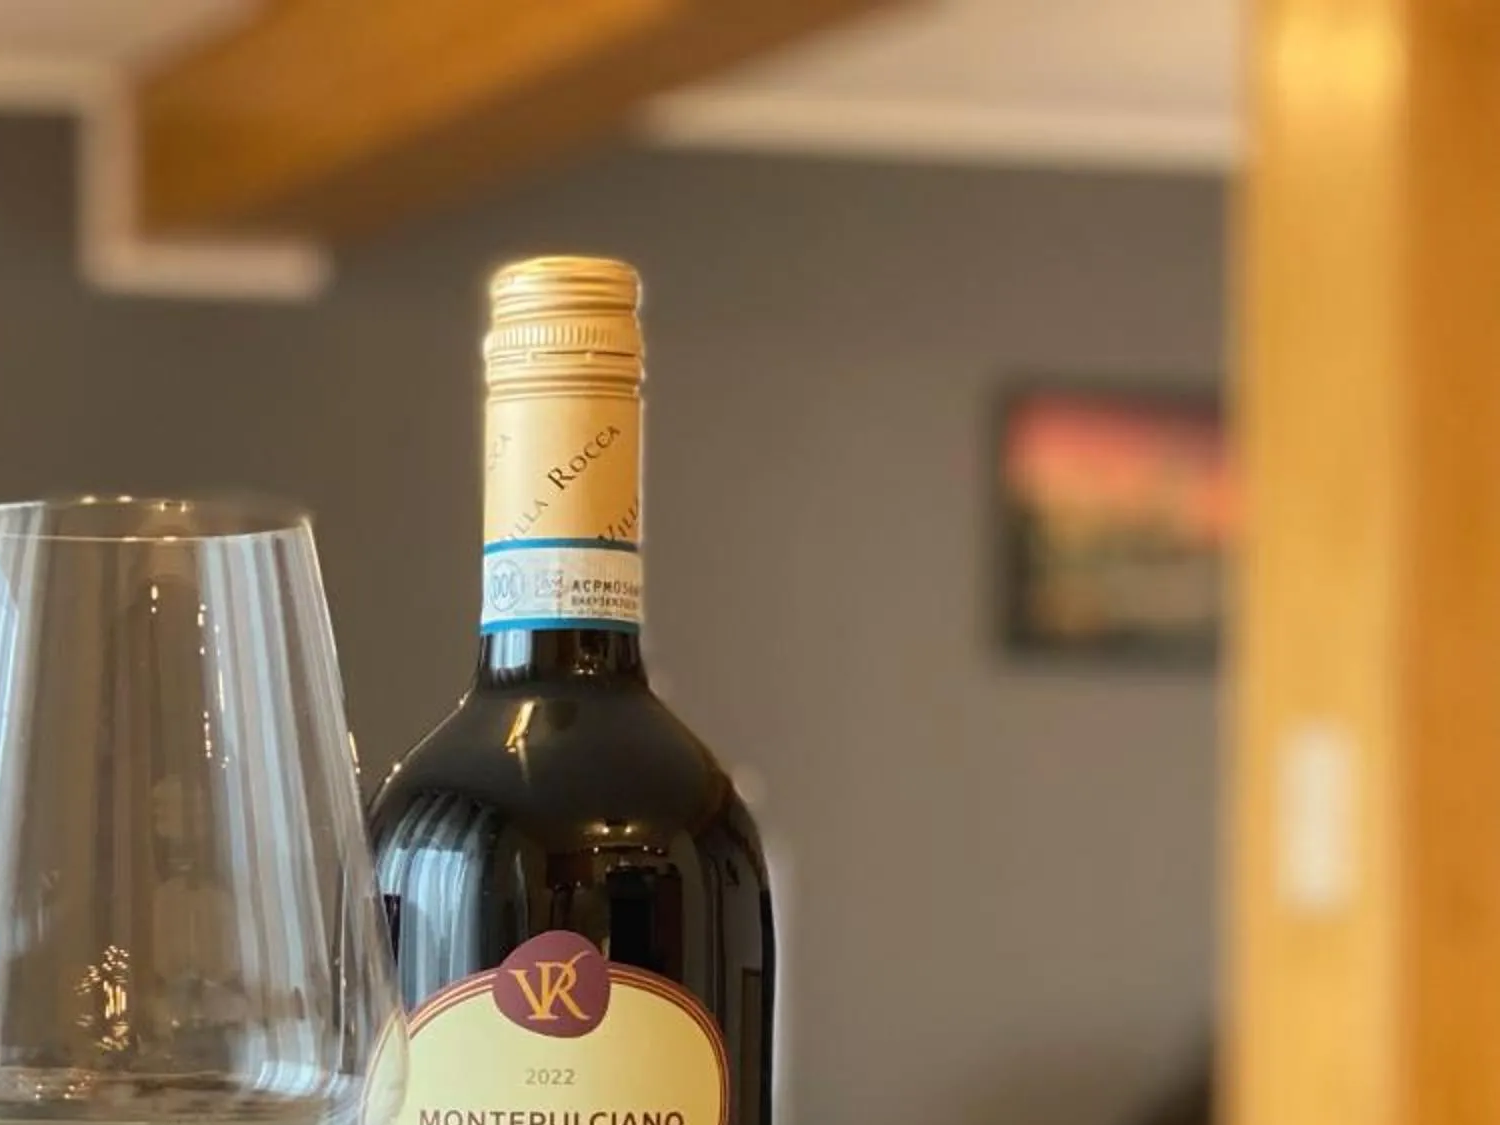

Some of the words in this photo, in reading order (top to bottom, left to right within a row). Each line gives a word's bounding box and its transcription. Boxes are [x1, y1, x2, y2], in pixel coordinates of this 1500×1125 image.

[547, 425, 621, 490] ROCCA
[508, 949, 592, 1020] VR
[524, 1068, 576, 1086] 2022
